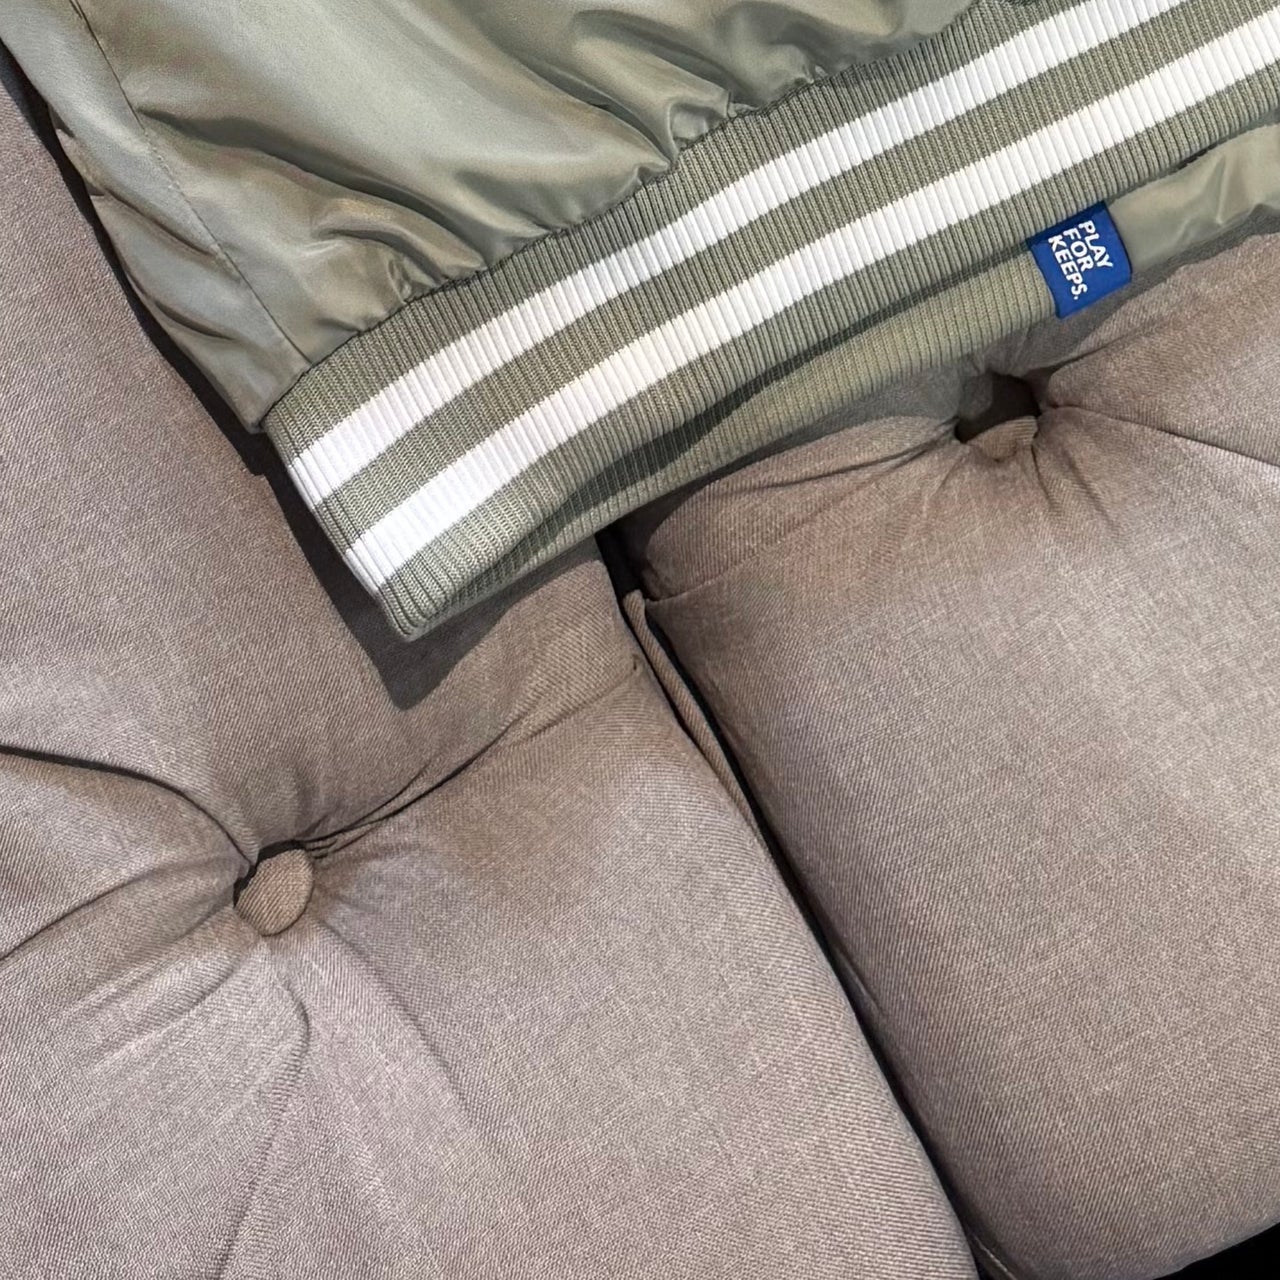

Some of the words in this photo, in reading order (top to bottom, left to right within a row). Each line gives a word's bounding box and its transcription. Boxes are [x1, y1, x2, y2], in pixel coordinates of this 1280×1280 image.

[1047, 235, 1088, 300] KEEPS.
[1063, 227, 1094, 272] FOR
[1078, 220, 1113, 268] PLAY
